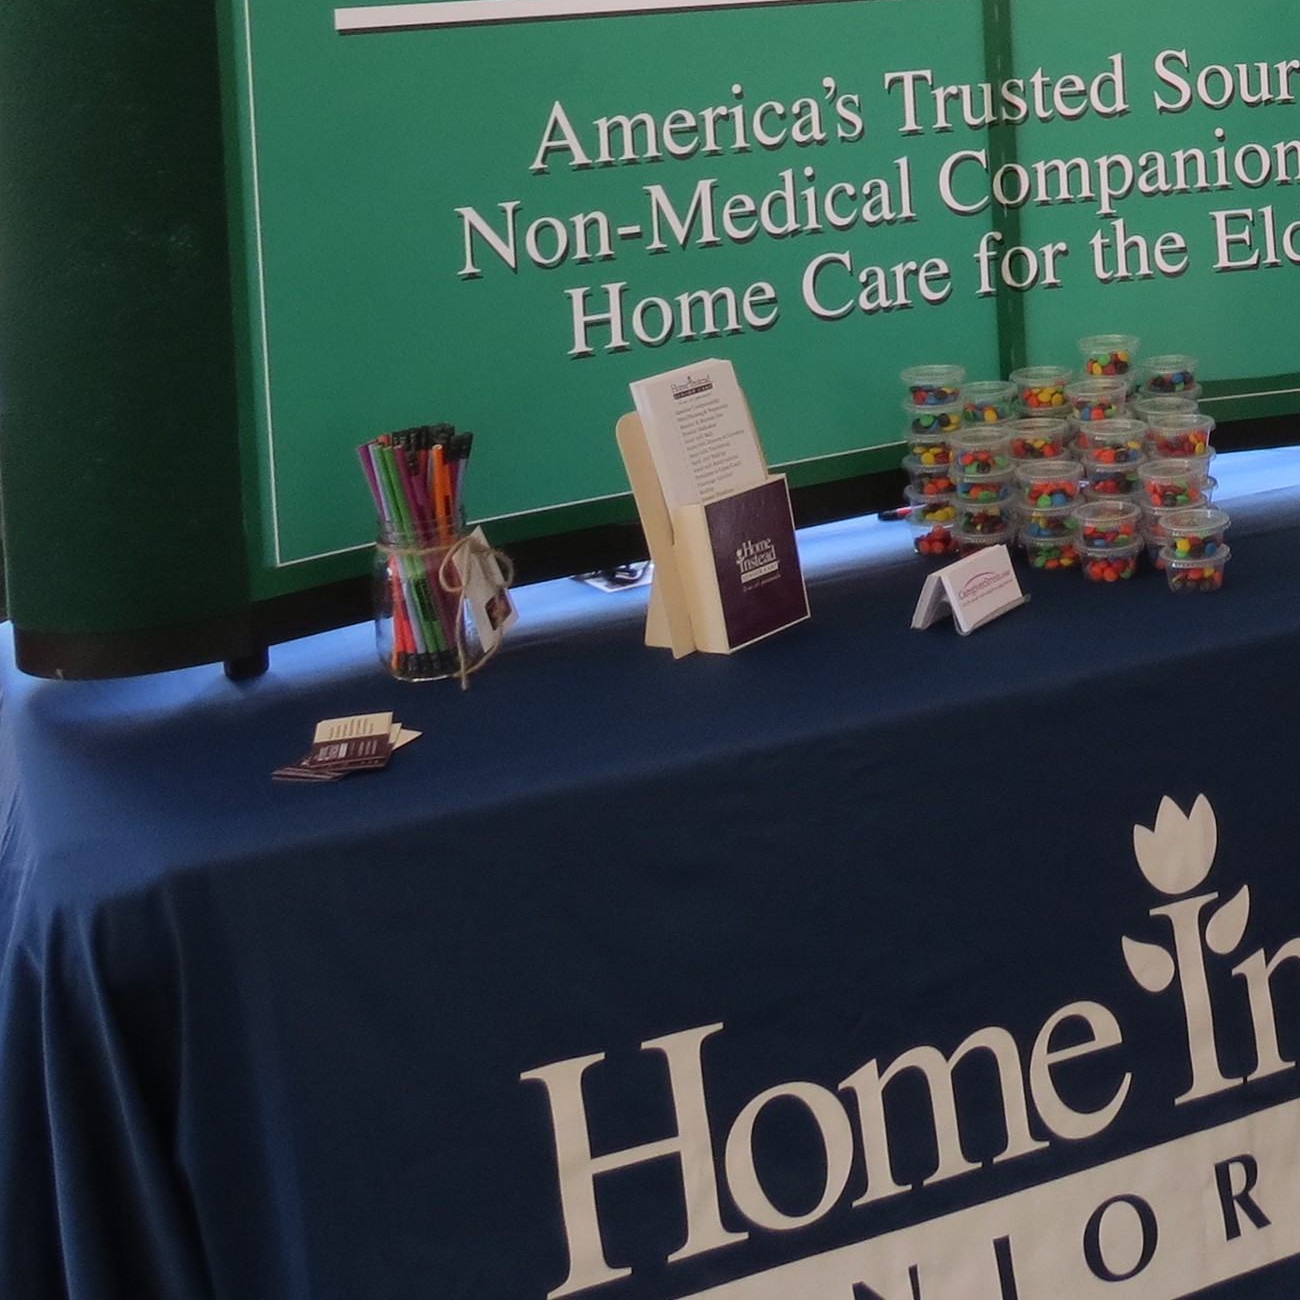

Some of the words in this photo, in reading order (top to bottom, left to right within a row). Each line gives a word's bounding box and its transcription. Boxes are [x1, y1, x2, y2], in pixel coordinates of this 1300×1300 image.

[529, 76, 866, 174] America's
[884, 52, 1130, 135] Trusted
[455, 156, 917, 278] Non-Medical
[564, 281, 779, 361] Home
[803, 250, 951, 320] Care
[974, 232, 1067, 295] for
[1090, 218, 1188, 282] the
[519, 1000, 1133, 1300] Home
